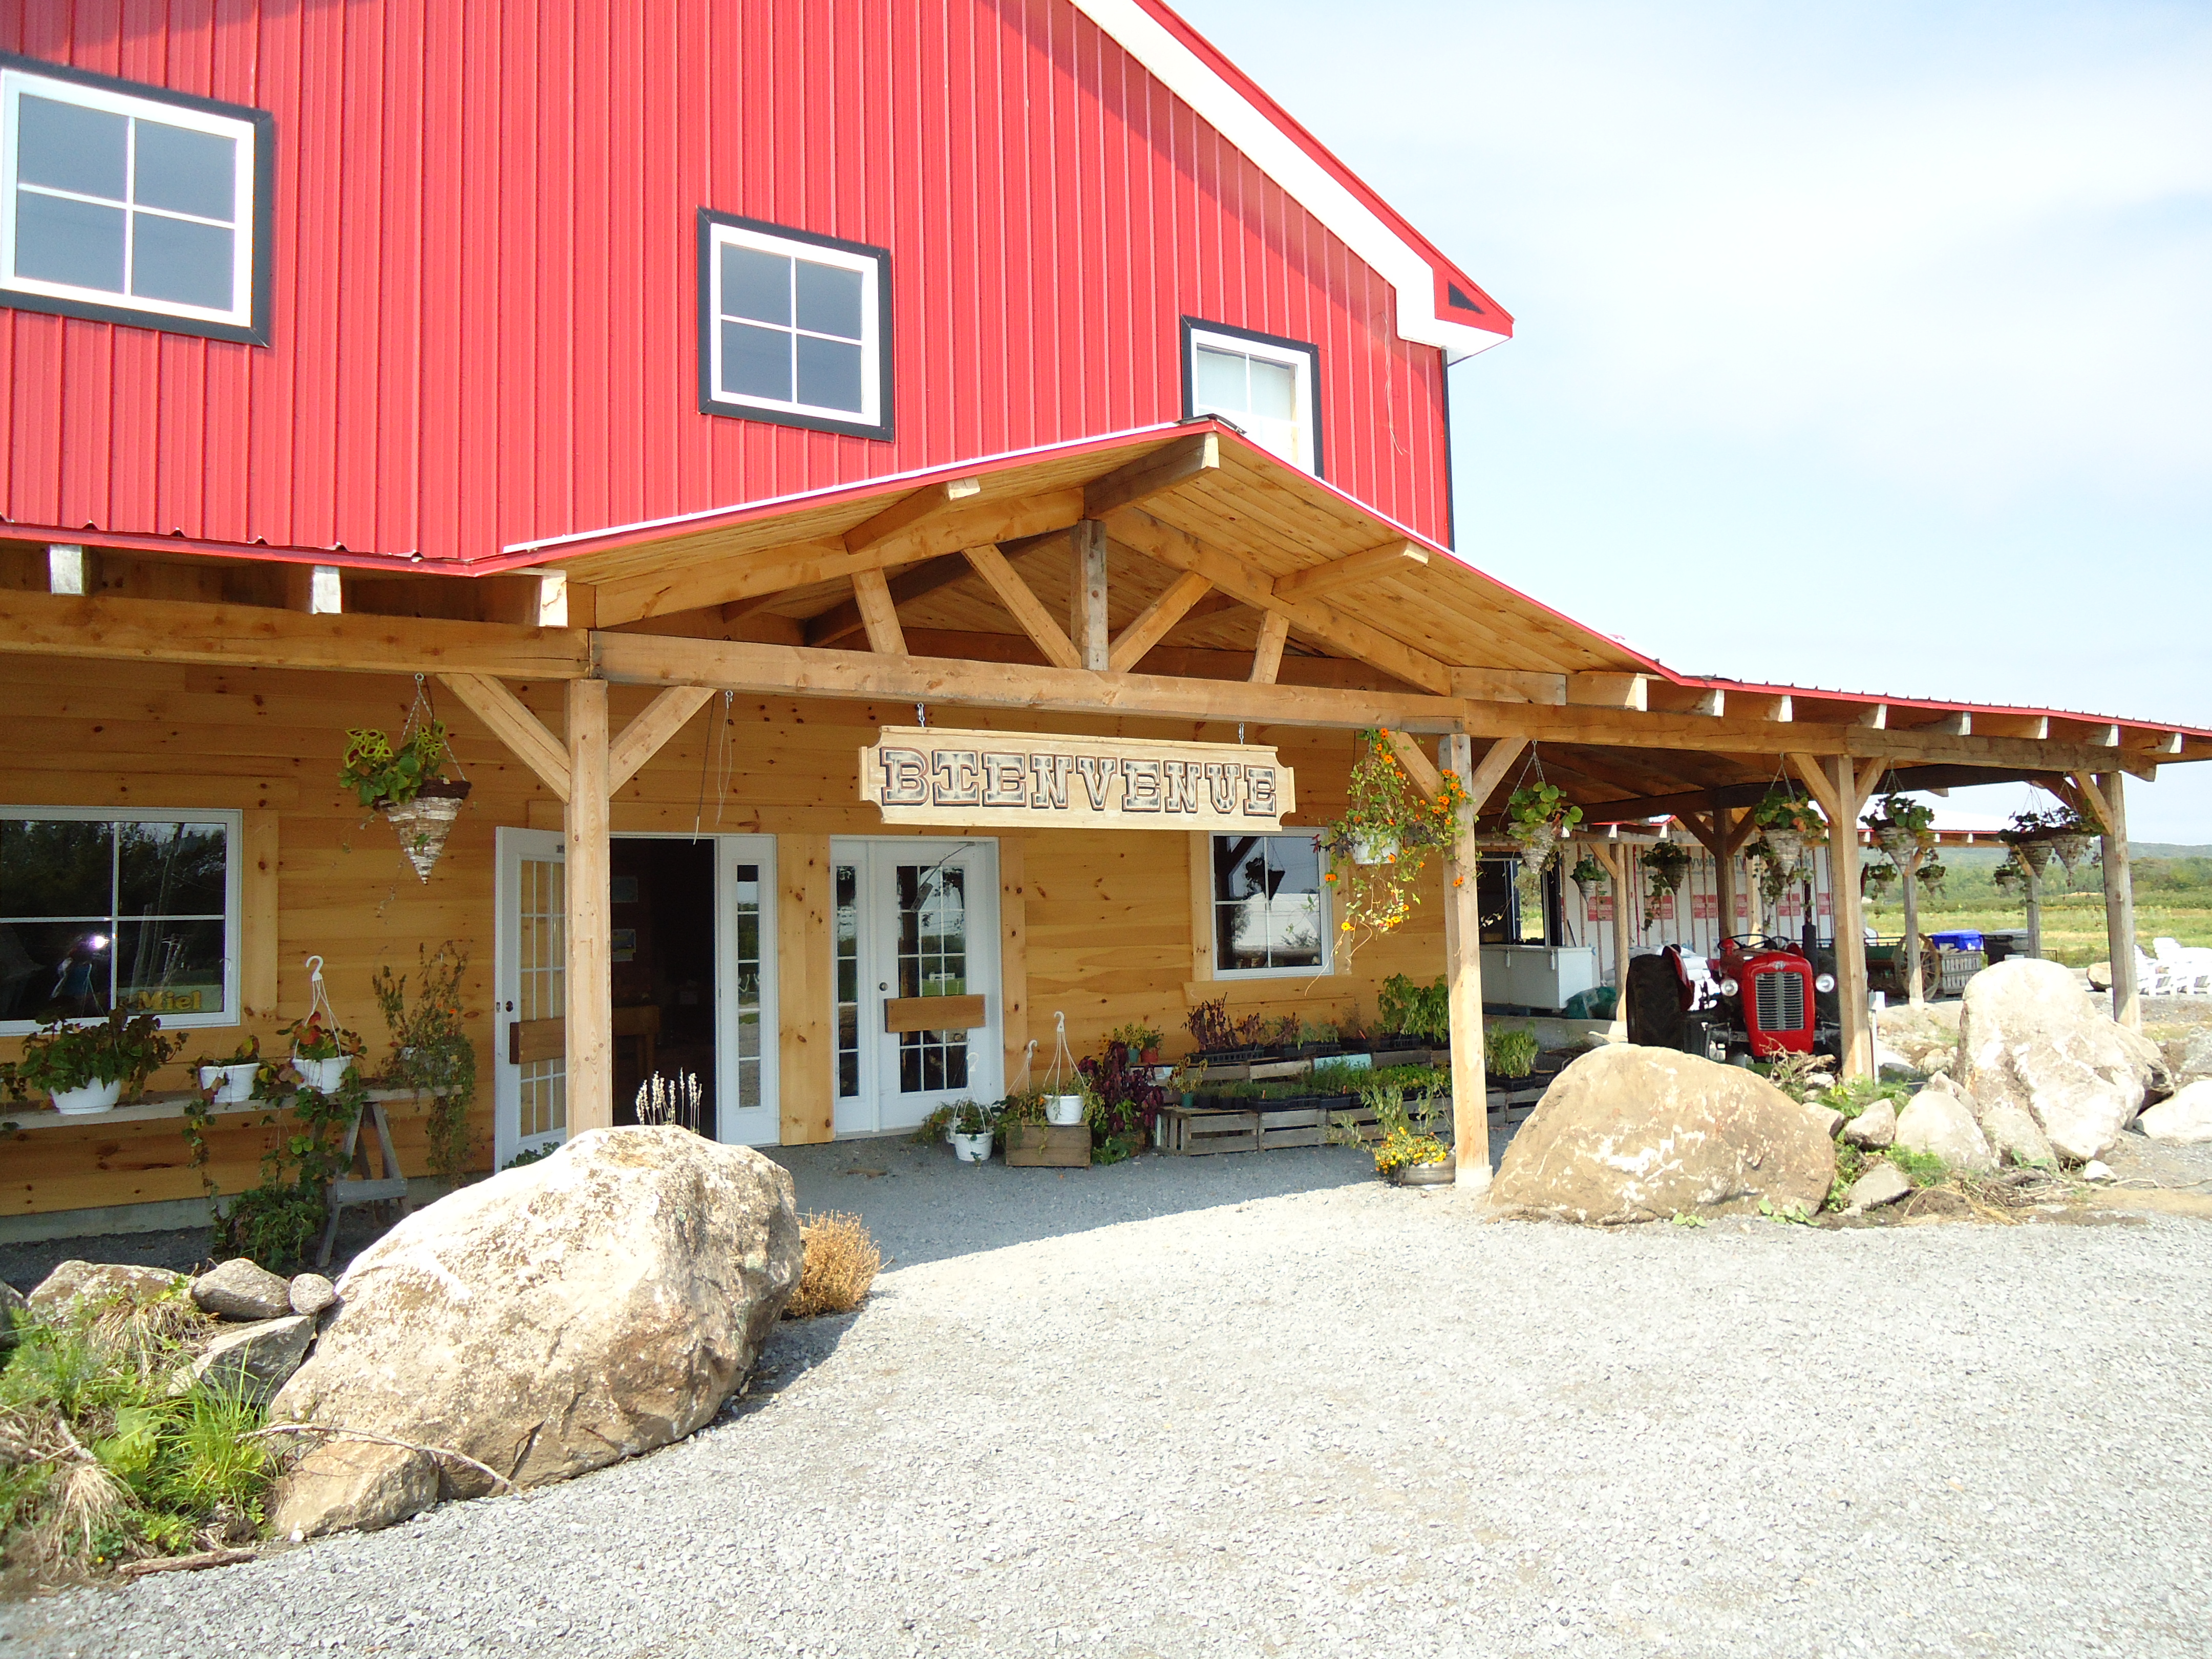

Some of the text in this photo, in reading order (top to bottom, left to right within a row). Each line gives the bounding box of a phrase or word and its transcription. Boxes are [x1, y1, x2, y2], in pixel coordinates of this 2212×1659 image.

[880, 747, 1277, 817] BIENVENUE
[1691, 854, 1715, 869] yvek
[136, 990, 201, 1010] Miel
